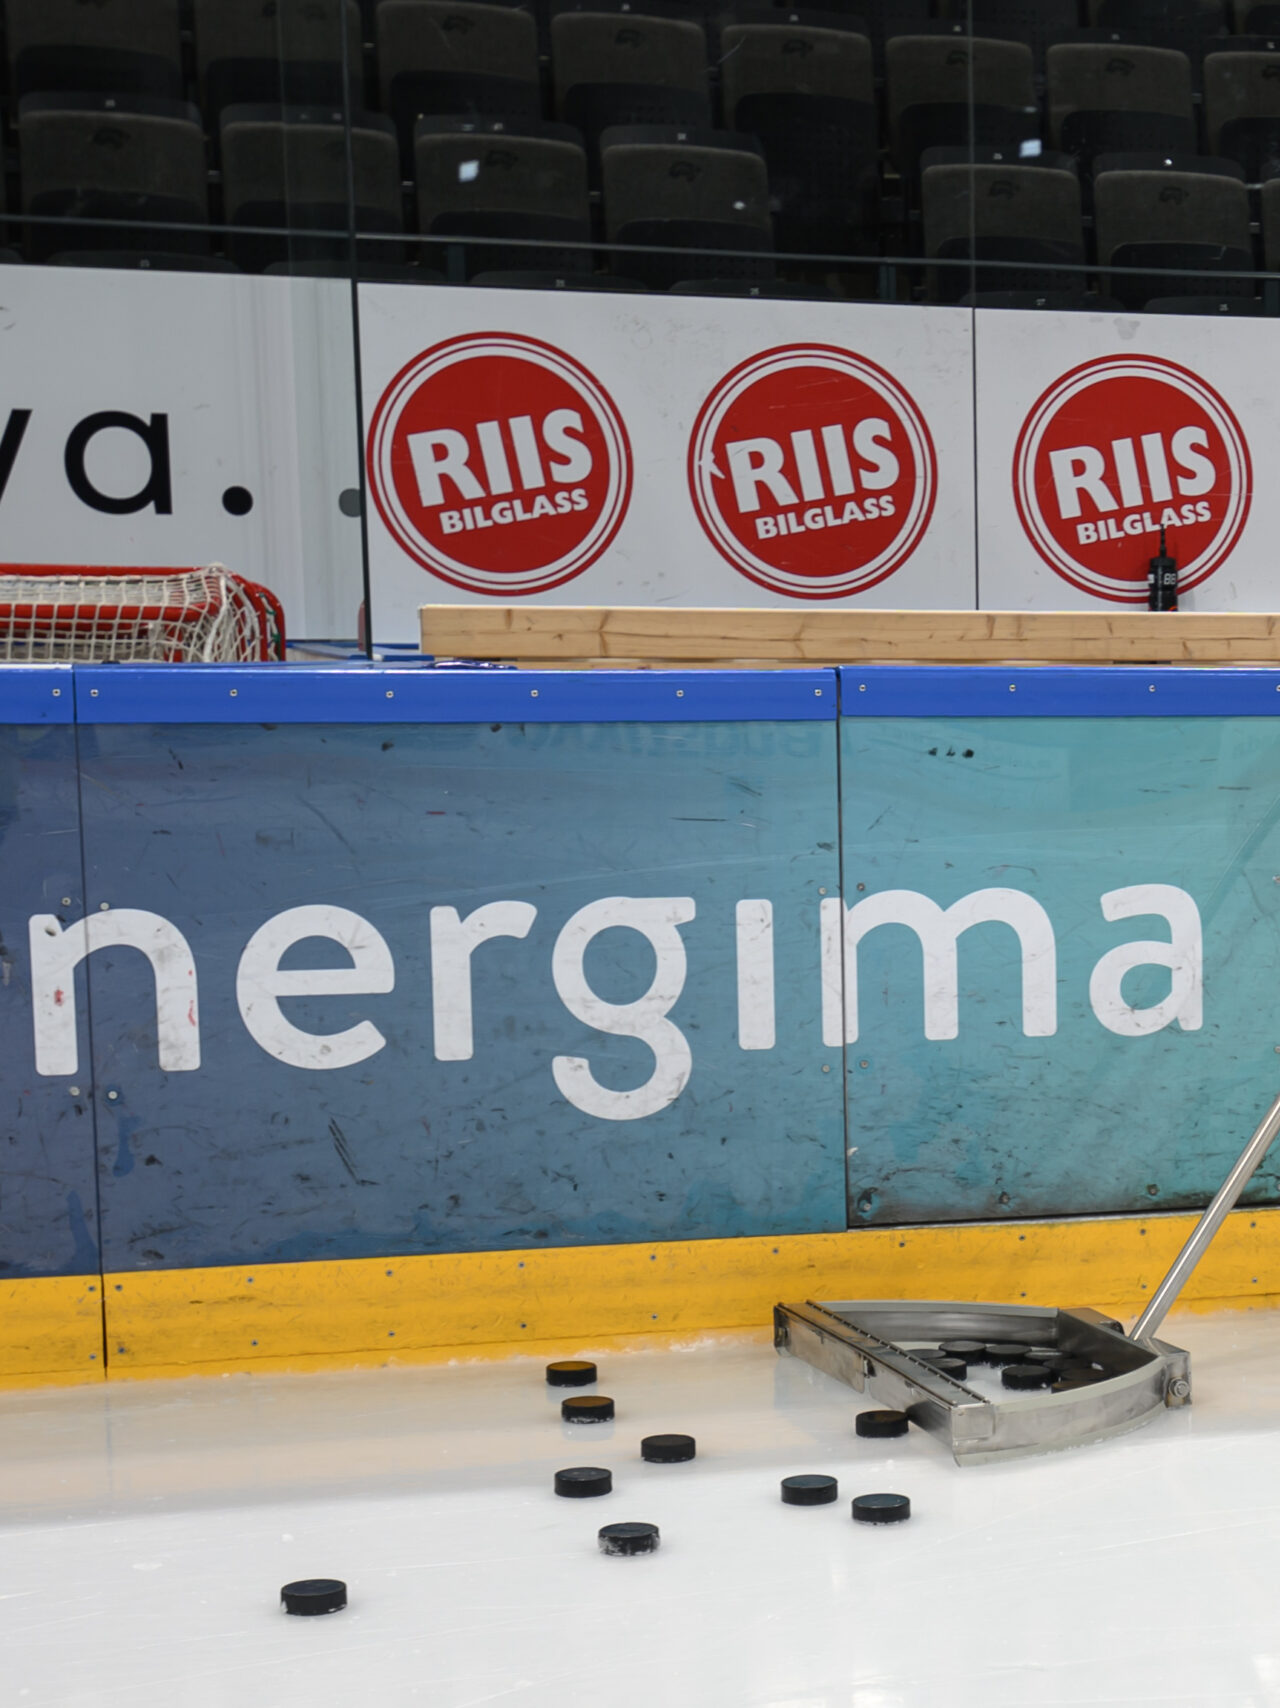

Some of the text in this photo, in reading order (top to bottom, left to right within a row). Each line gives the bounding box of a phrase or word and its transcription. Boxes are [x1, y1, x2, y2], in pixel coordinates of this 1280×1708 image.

[407, 409, 593, 507] RIIS
[726, 418, 899, 513] RIIS
[1049, 426, 1215, 520] RIIS
[440, 489, 589, 534] BILGLASS
[756, 495, 895, 540] BILGLASS
[1077, 502, 1211, 545] BILGLASS
